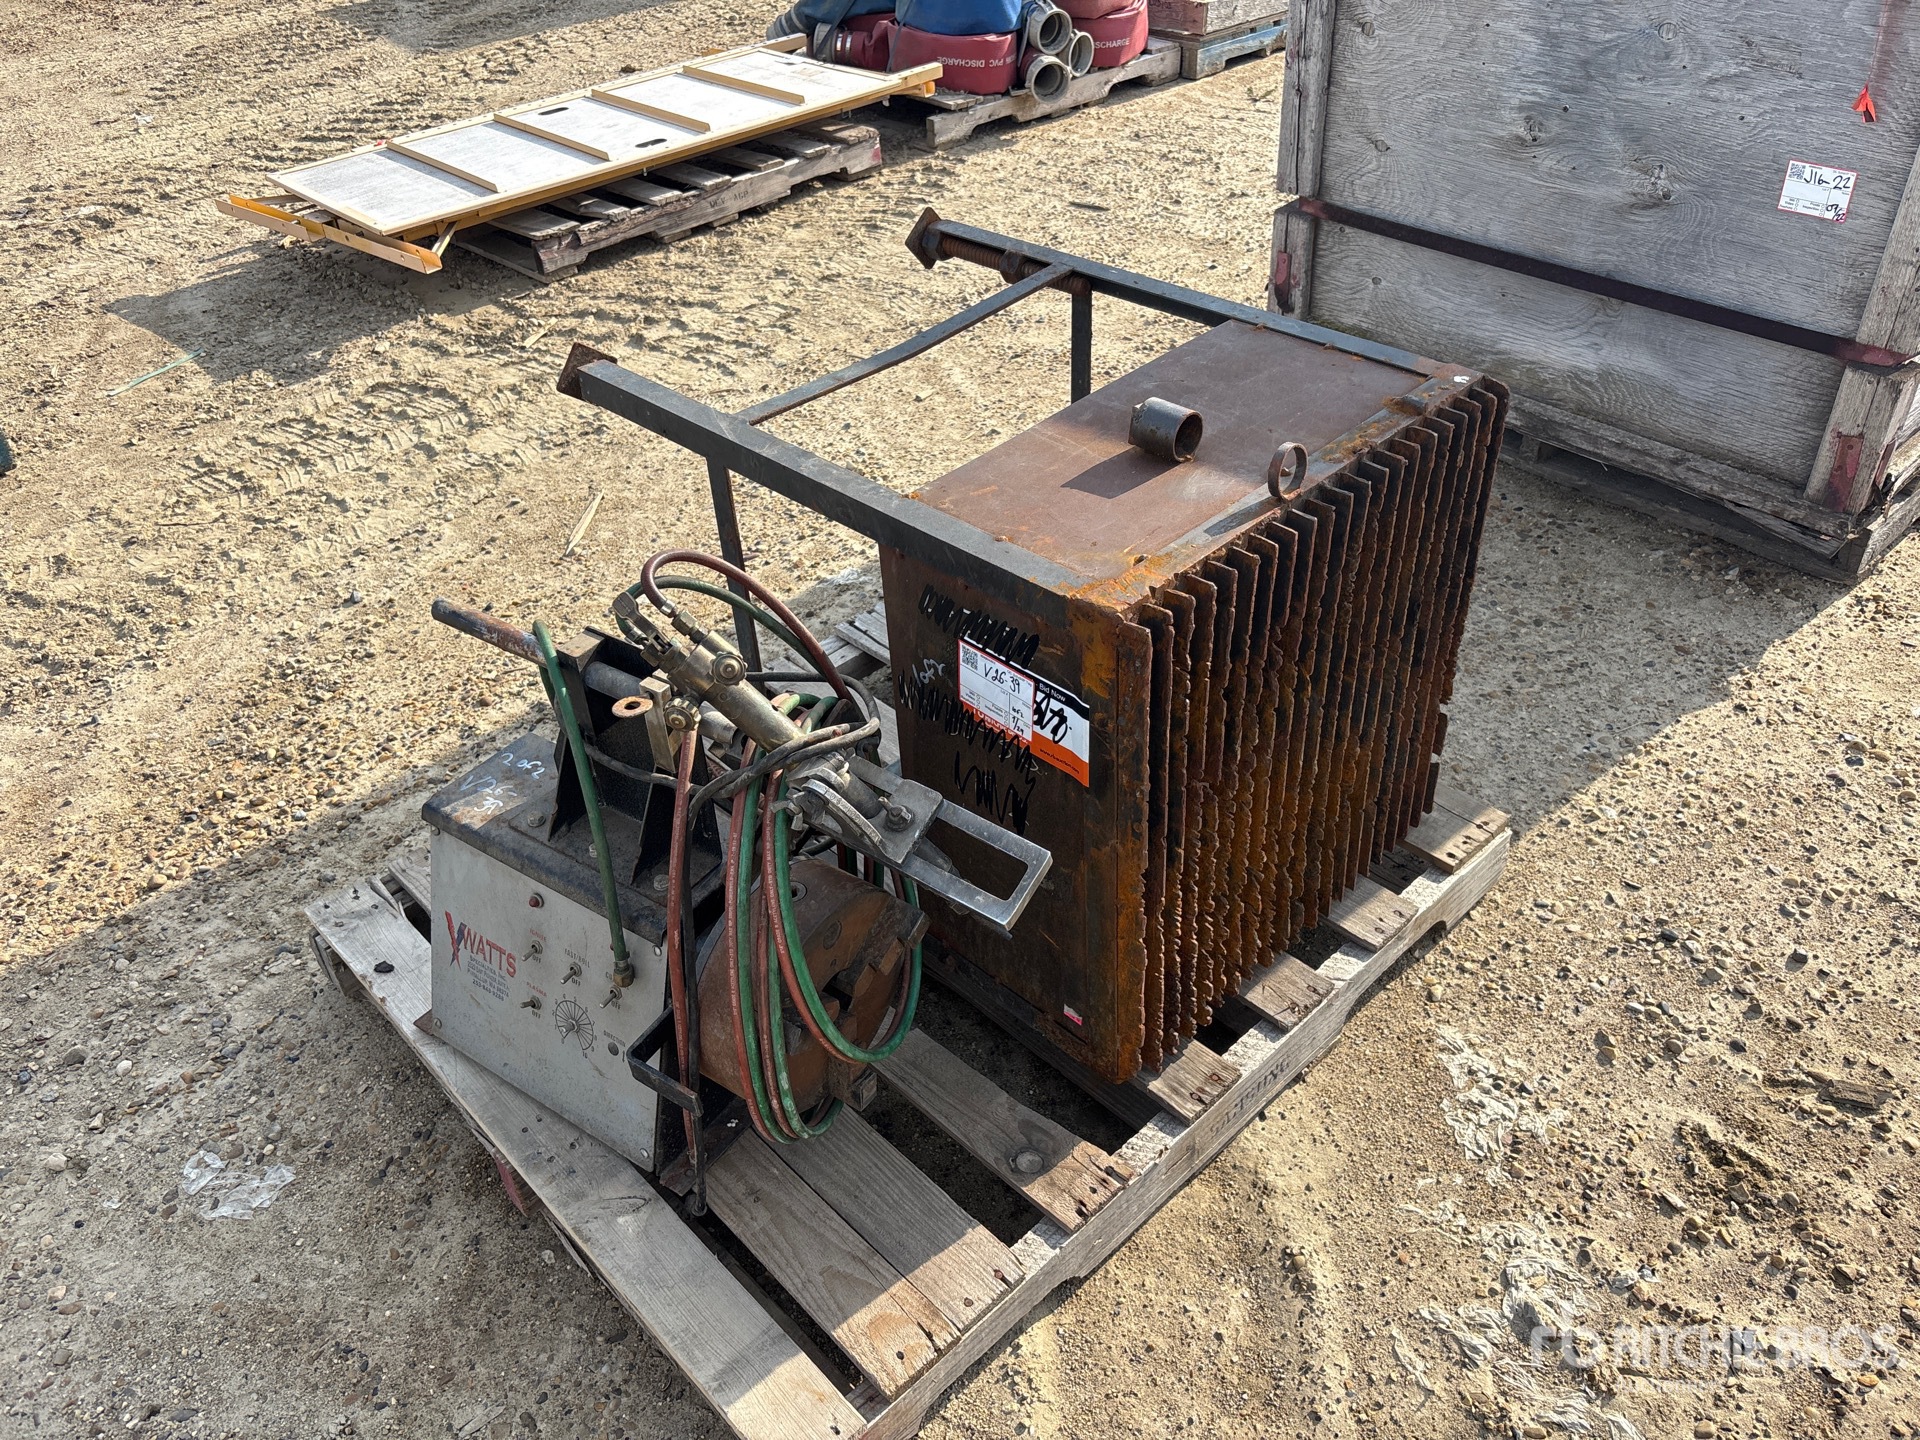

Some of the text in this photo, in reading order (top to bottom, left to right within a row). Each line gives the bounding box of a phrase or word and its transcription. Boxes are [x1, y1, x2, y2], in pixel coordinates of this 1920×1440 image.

[1093, 37, 1131, 49] SCHARGE
[936, 56, 986, 68] DISCHARGE
[989, 58, 1004, 67] PVC
[1039, 682, 1067, 703] Bid Now
[501, 752, 514, 767] 2
